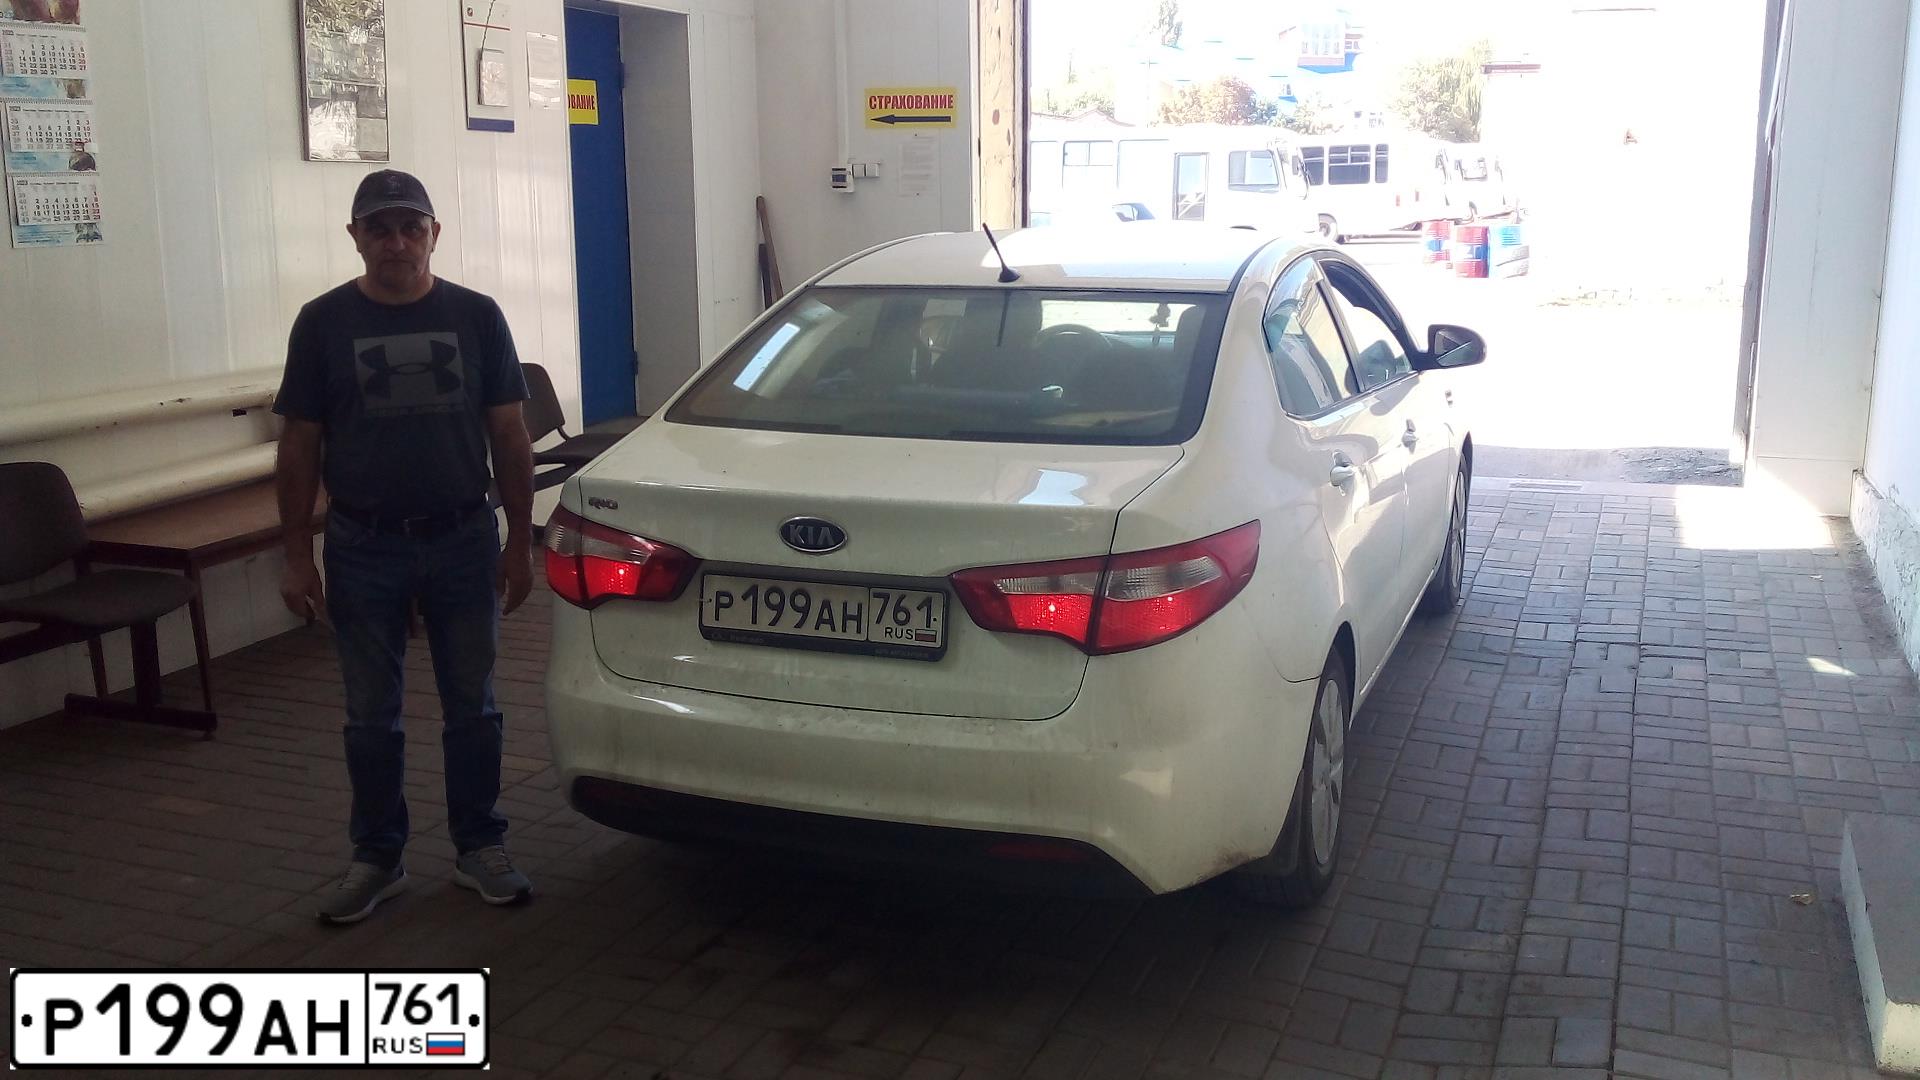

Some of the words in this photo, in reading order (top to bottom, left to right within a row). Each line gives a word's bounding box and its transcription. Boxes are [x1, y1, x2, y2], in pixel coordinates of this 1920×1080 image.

[869, 95, 953, 109] СТРАХОВАНИЕ
[789, 525, 834, 545] KIA
[872, 592, 932, 628] 761
[884, 626, 914, 640] RUS
